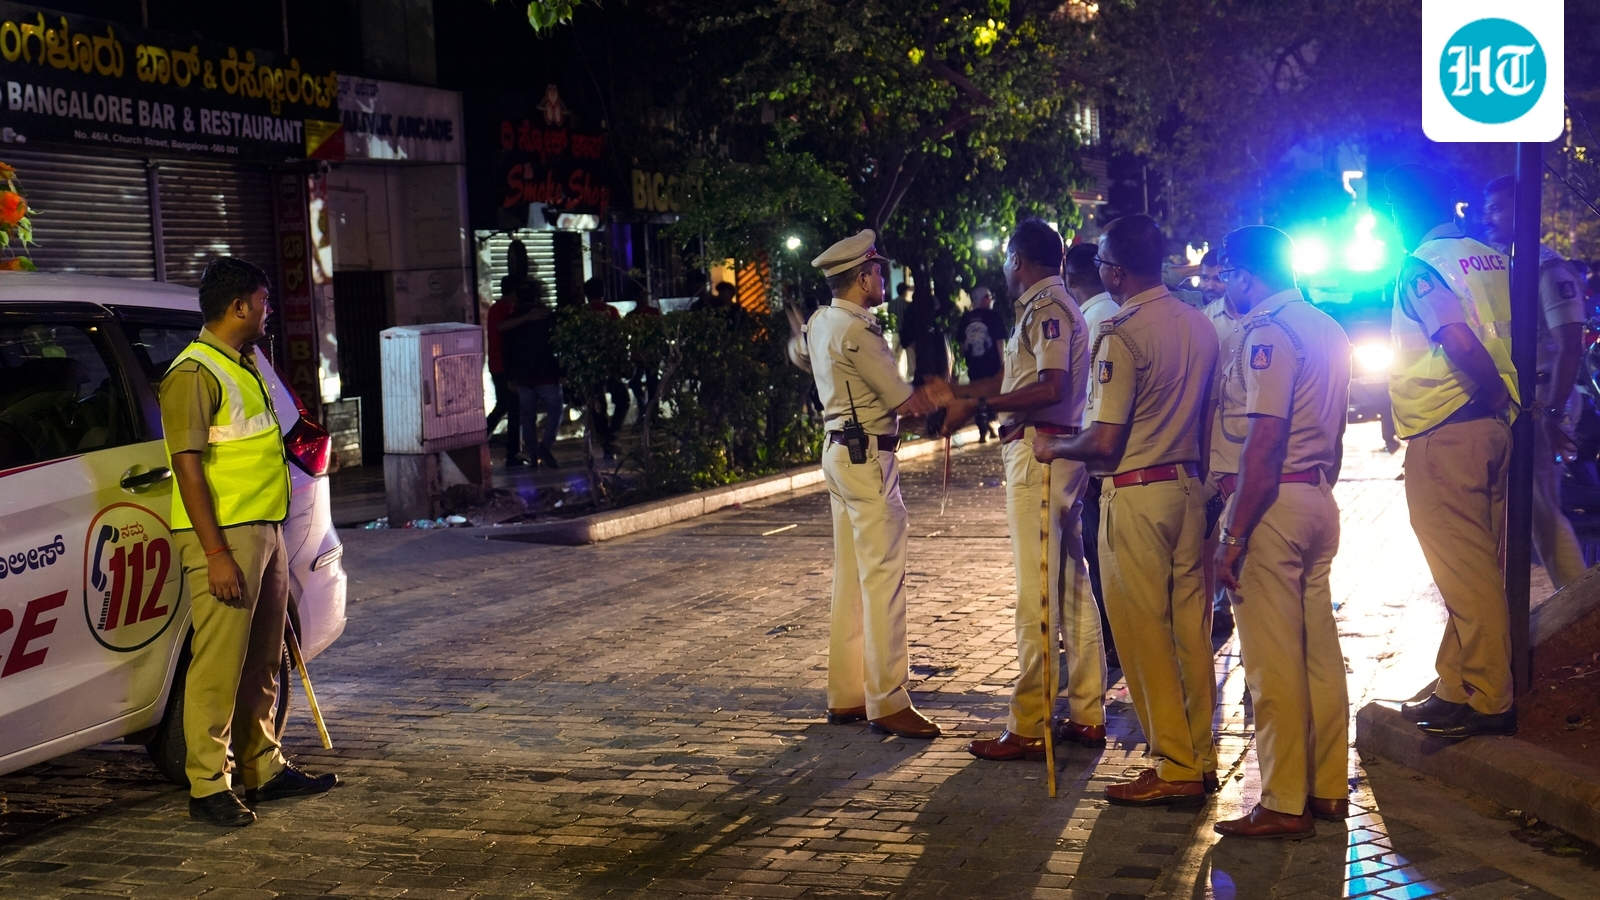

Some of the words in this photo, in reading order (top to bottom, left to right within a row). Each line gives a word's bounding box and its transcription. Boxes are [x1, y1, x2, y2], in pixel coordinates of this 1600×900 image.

[0, 11, 125, 78] ಂಗಳೂರು
[135, 43, 200, 88] ಬಾರ್
[202, 59, 218, 90] &
[7, 81, 134, 126] BANGALORE
[138, 100, 177, 131] BAR
[182, 106, 196, 133] &
[199, 108, 303, 145] RESTAURANT
[397, 115, 454, 142] ARCADE
[74, 130, 90, 140] No.
[113, 134, 143, 146] Church
[144, 138, 170, 149] Street,
[171, 140, 209, 154] Bangalore
[503, 163, 564, 209] Smoke
[565, 168, 610, 220] Shop
[1459, 254, 1506, 275] POLICE
[291, 341, 315, 410] BAR
[120, 521, 149, 542] ನಮ್ಮ
[0, 534, 65, 580] ಲೀಸ್
[104, 537, 171, 632] 112
[97, 590, 111, 630] Namma
